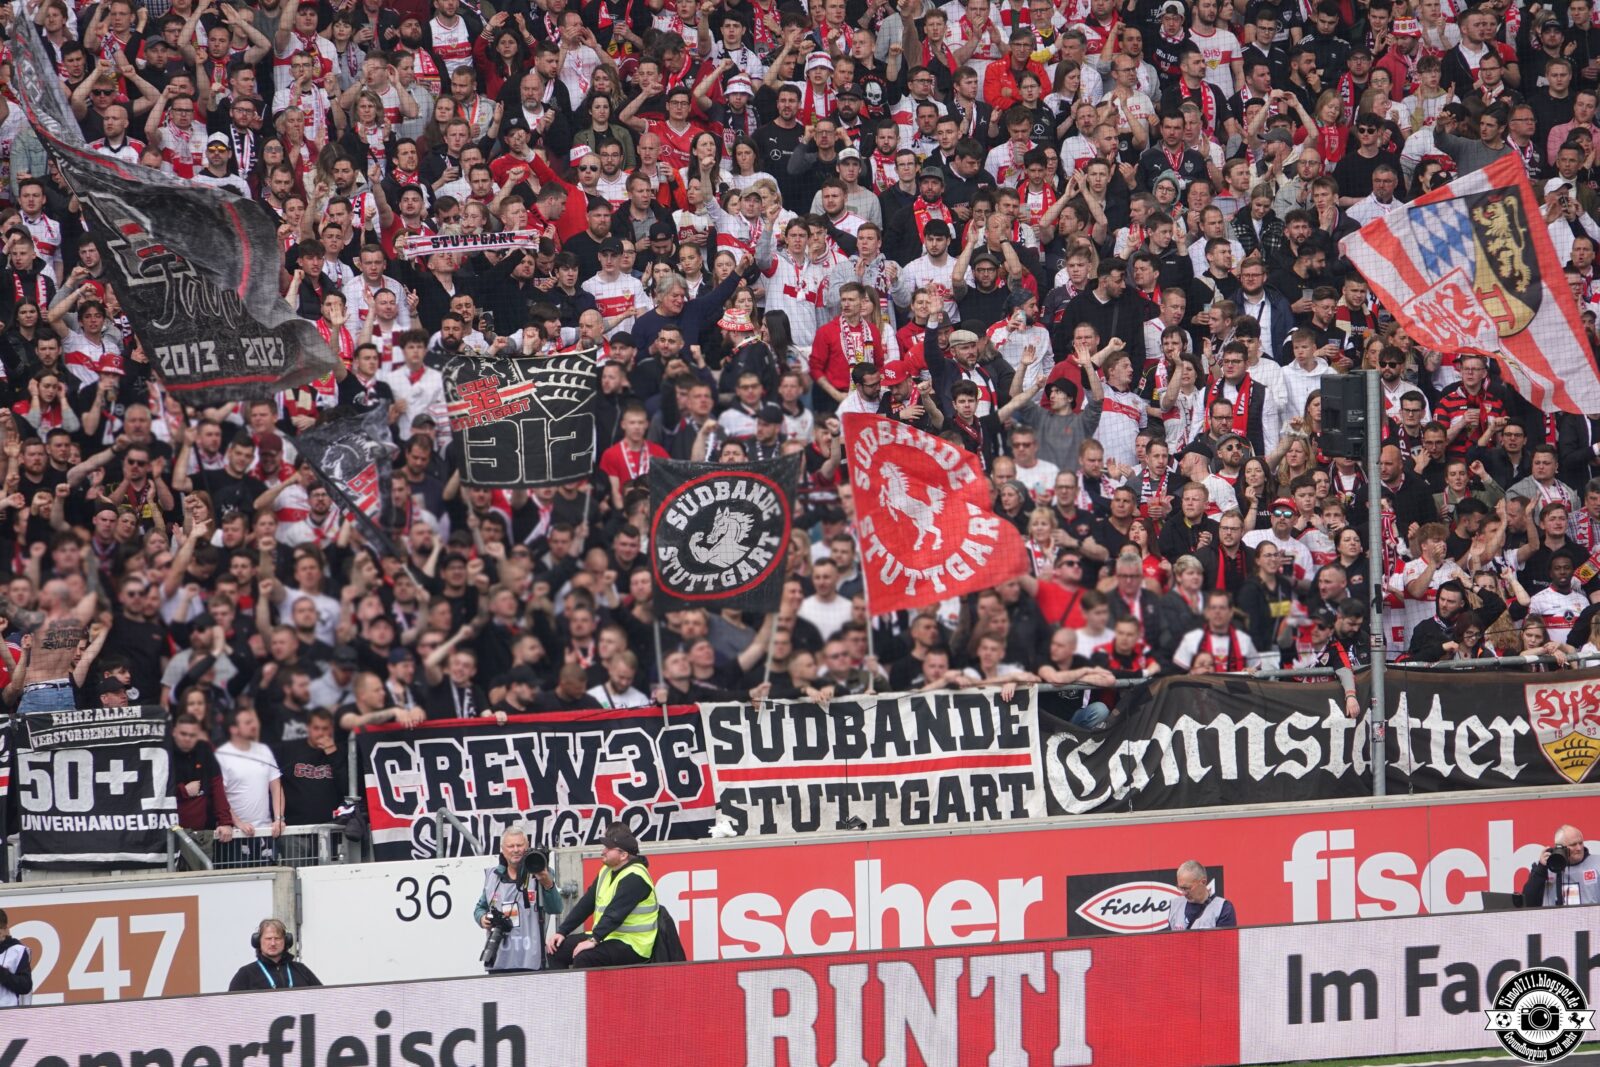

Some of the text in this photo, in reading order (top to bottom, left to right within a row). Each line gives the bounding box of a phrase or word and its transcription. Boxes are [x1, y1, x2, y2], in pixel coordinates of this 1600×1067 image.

[431, 233, 515, 248] STUTTGART
[155, 341, 220, 376] 2013
[456, 375, 500, 396] CREW
[463, 388, 502, 416] 36
[450, 398, 530, 431] STUTTGART
[463, 412, 595, 484] 312
[665, 480, 782, 531] SÜDBANDE
[658, 531, 780, 592] STUTTGART
[30, 727, 120, 748] VERSTORBENEN
[121, 723, 165, 739] ULTRAS
[51, 705, 141, 727] EHRE ALLEN
[17, 746, 177, 812] 50+1
[719, 772, 1036, 836] STUTTGART
[1283, 819, 1600, 923] fisch
[395, 874, 453, 922] 36
[654, 858, 1043, 961] fischer
[1100, 896, 1171, 916] fische
[9, 911, 185, 1006] 247
[737, 949, 1093, 1067] RINTI
[1287, 953, 1379, 1025] Im
